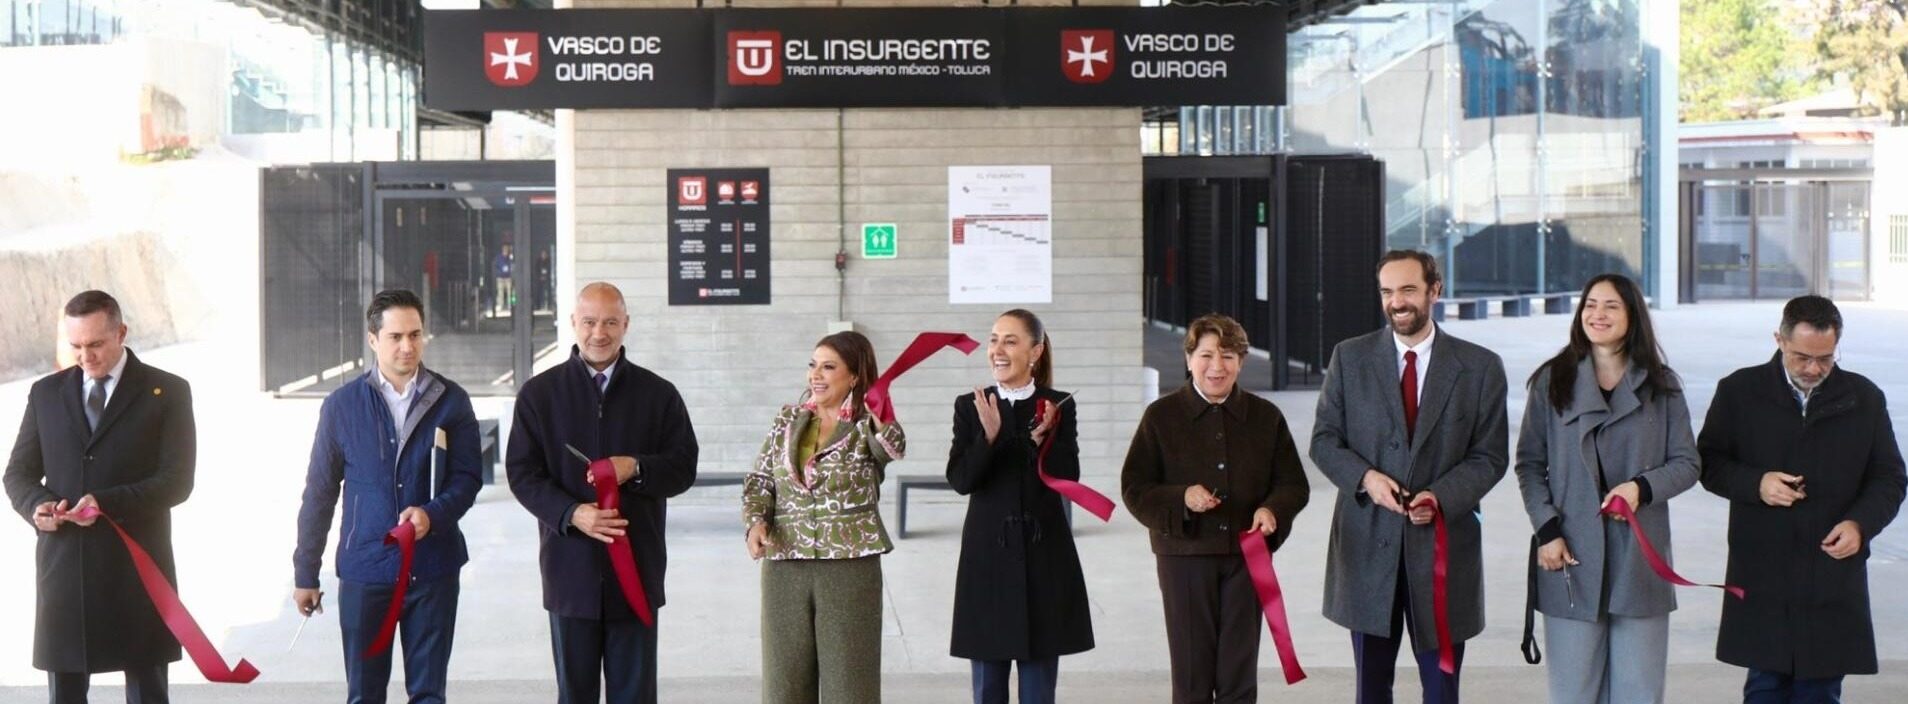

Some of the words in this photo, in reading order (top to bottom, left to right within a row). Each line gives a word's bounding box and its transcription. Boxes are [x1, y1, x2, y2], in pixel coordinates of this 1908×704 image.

[548, 37, 624, 54] VASCO
[631, 37, 660, 54] DE
[786, 40, 818, 60] EL
[824, 39, 990, 60] INSURGENTE
[1124, 34, 1198, 51] VASCO
[1205, 34, 1234, 51] DE
[556, 63, 653, 81] QUIROGA
[786, 66, 816, 75] TREN
[819, 66, 896, 75] INTERURBANO
[898, 63, 940, 75] MÉXICO
[1131, 61, 1227, 78] QUIROGA
